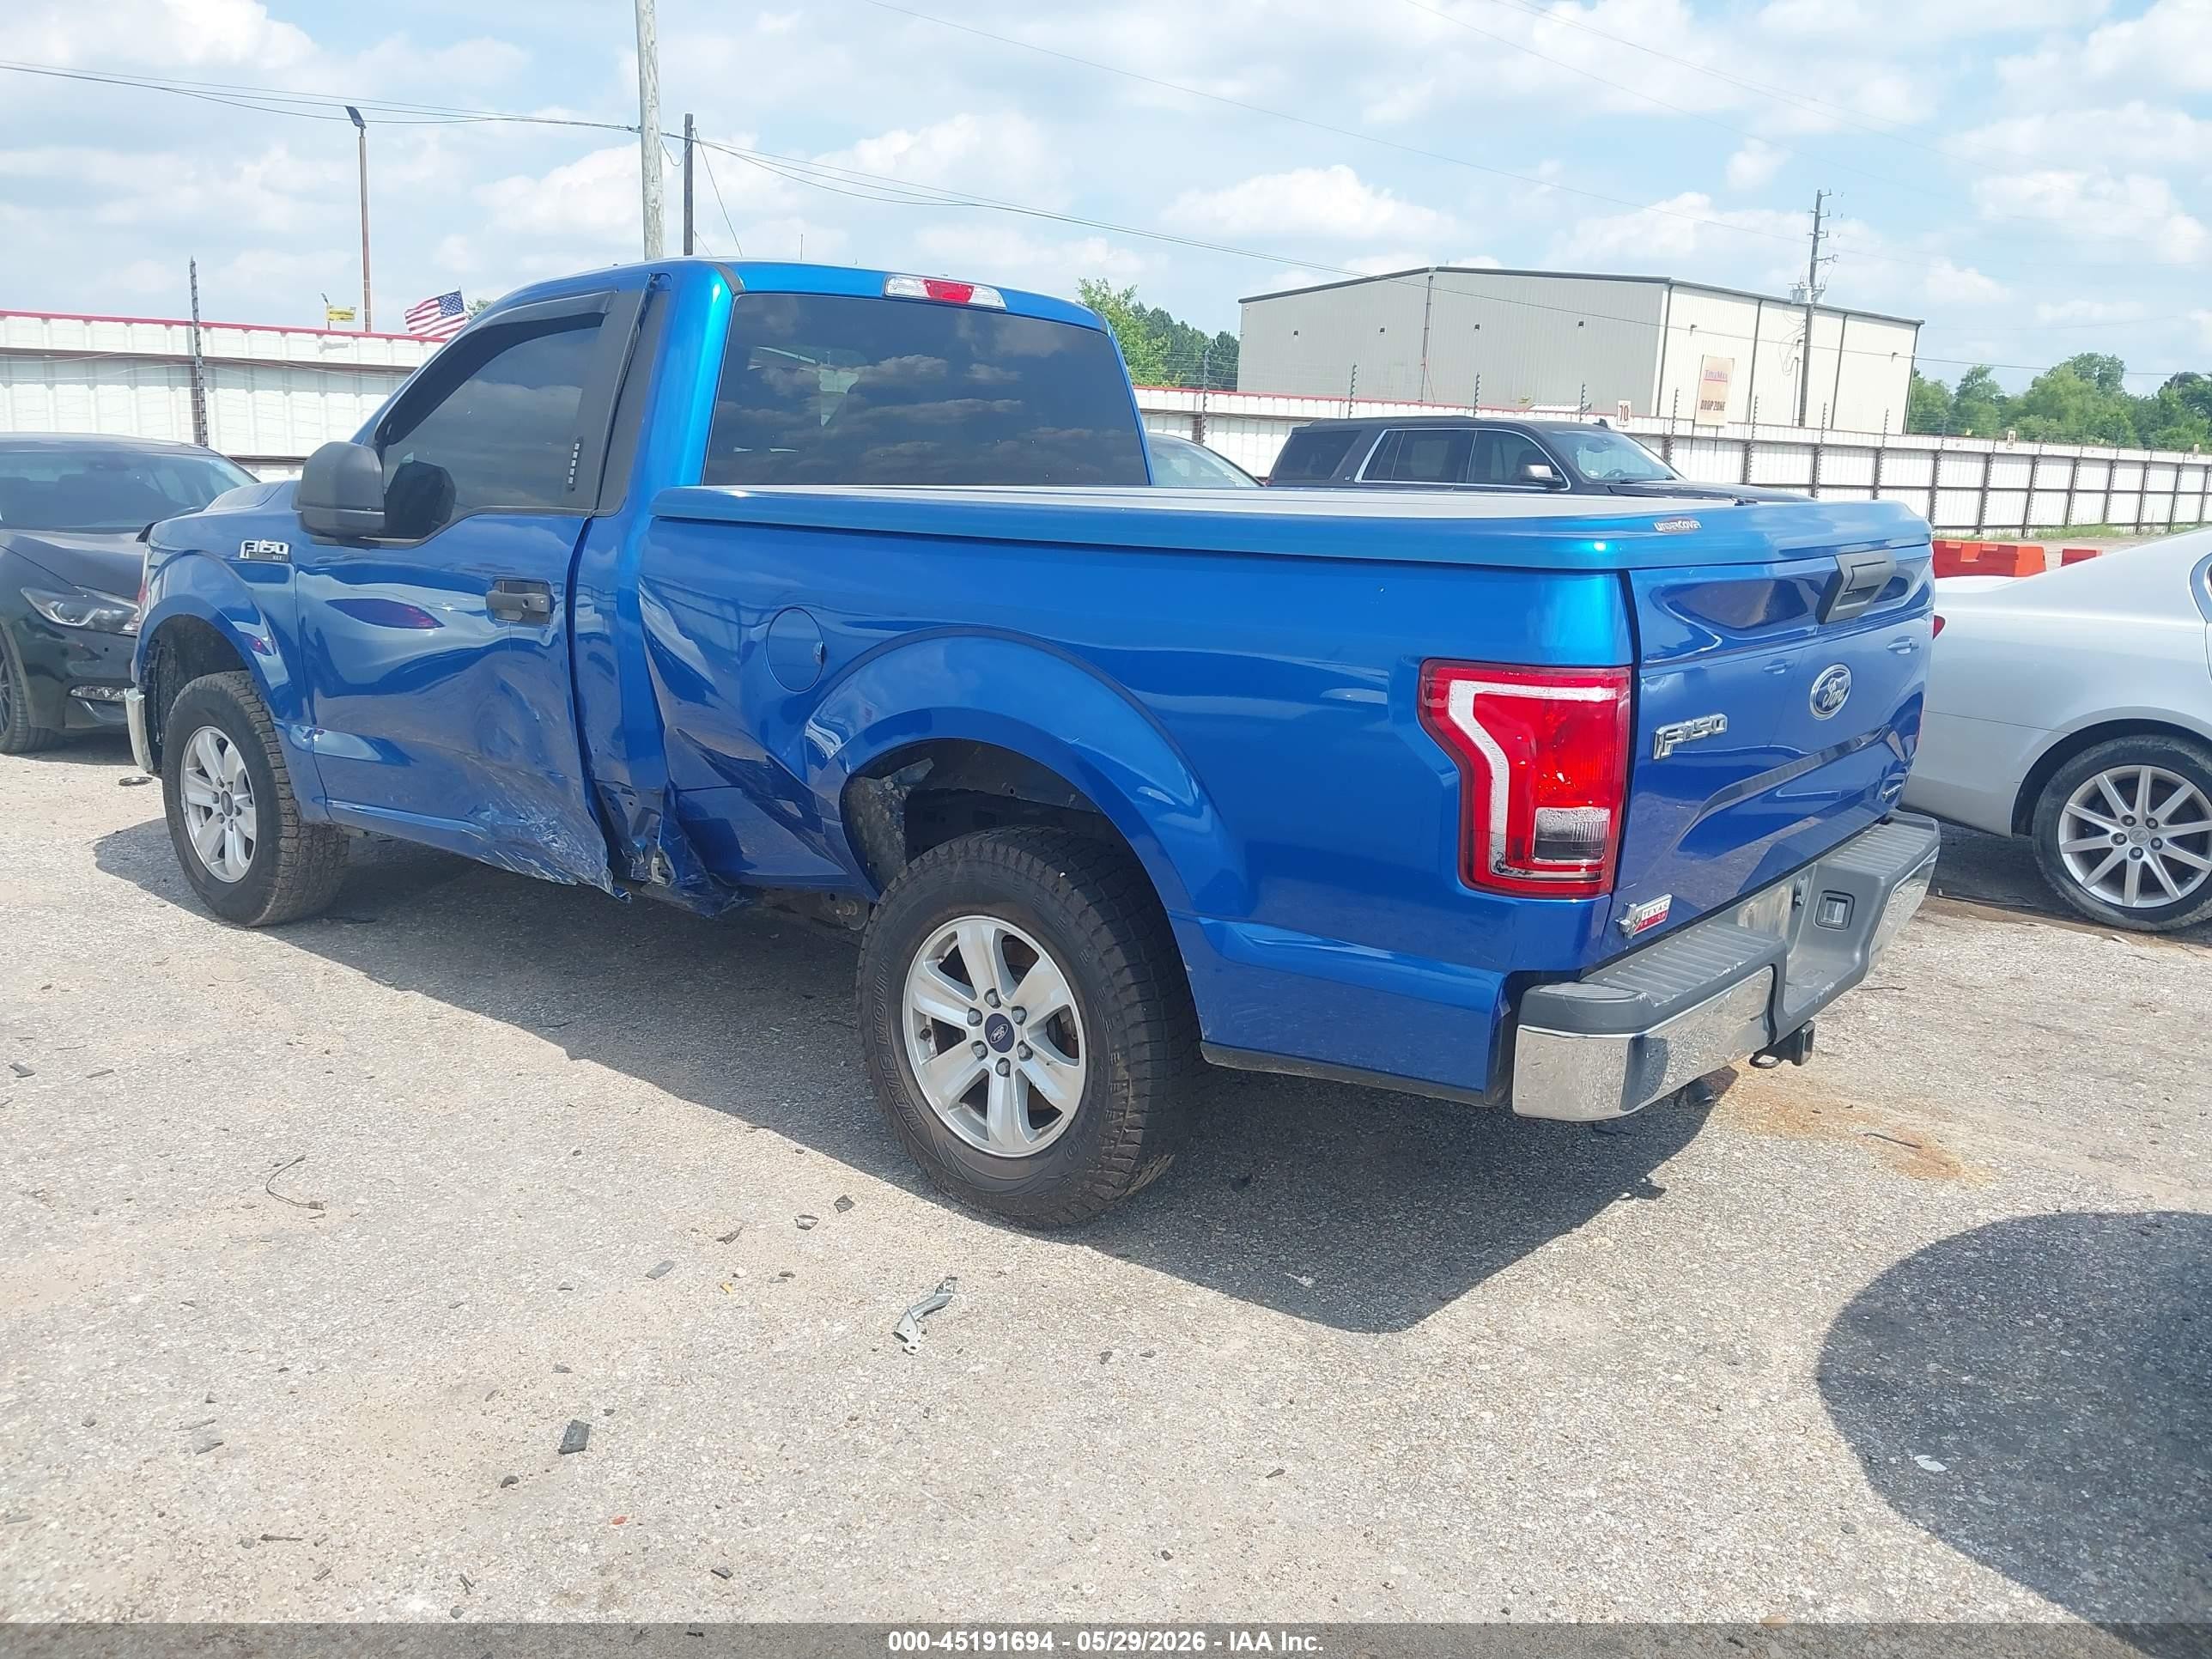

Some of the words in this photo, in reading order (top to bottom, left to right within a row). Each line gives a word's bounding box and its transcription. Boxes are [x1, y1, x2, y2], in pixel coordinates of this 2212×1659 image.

[1619, 404, 1629, 421] 70
[1700, 399, 1714, 410] DROP
[1713, 400, 1726, 411] ZONE
[1643, 902, 1669, 918] TEXAS
